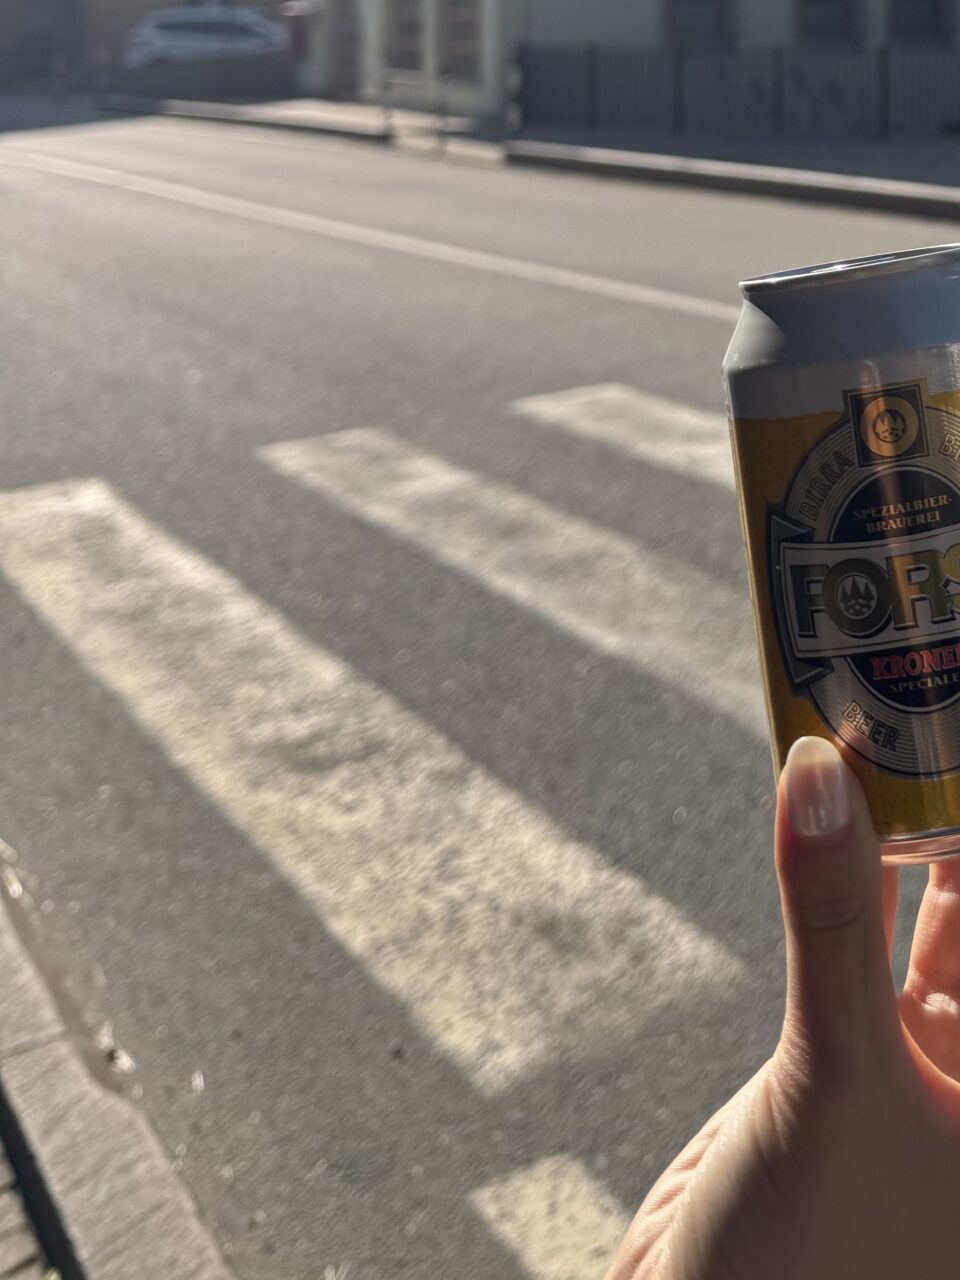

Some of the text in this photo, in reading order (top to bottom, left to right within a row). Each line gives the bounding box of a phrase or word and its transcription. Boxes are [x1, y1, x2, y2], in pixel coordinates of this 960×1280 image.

[799, 450, 855, 521] BIRRA
[852, 494, 952, 521] SPEZIALBIER-
[865, 510, 941, 534] BRAUEREI
[888, 672, 960, 693] SPECIALE
[841, 700, 901, 752] BEER
